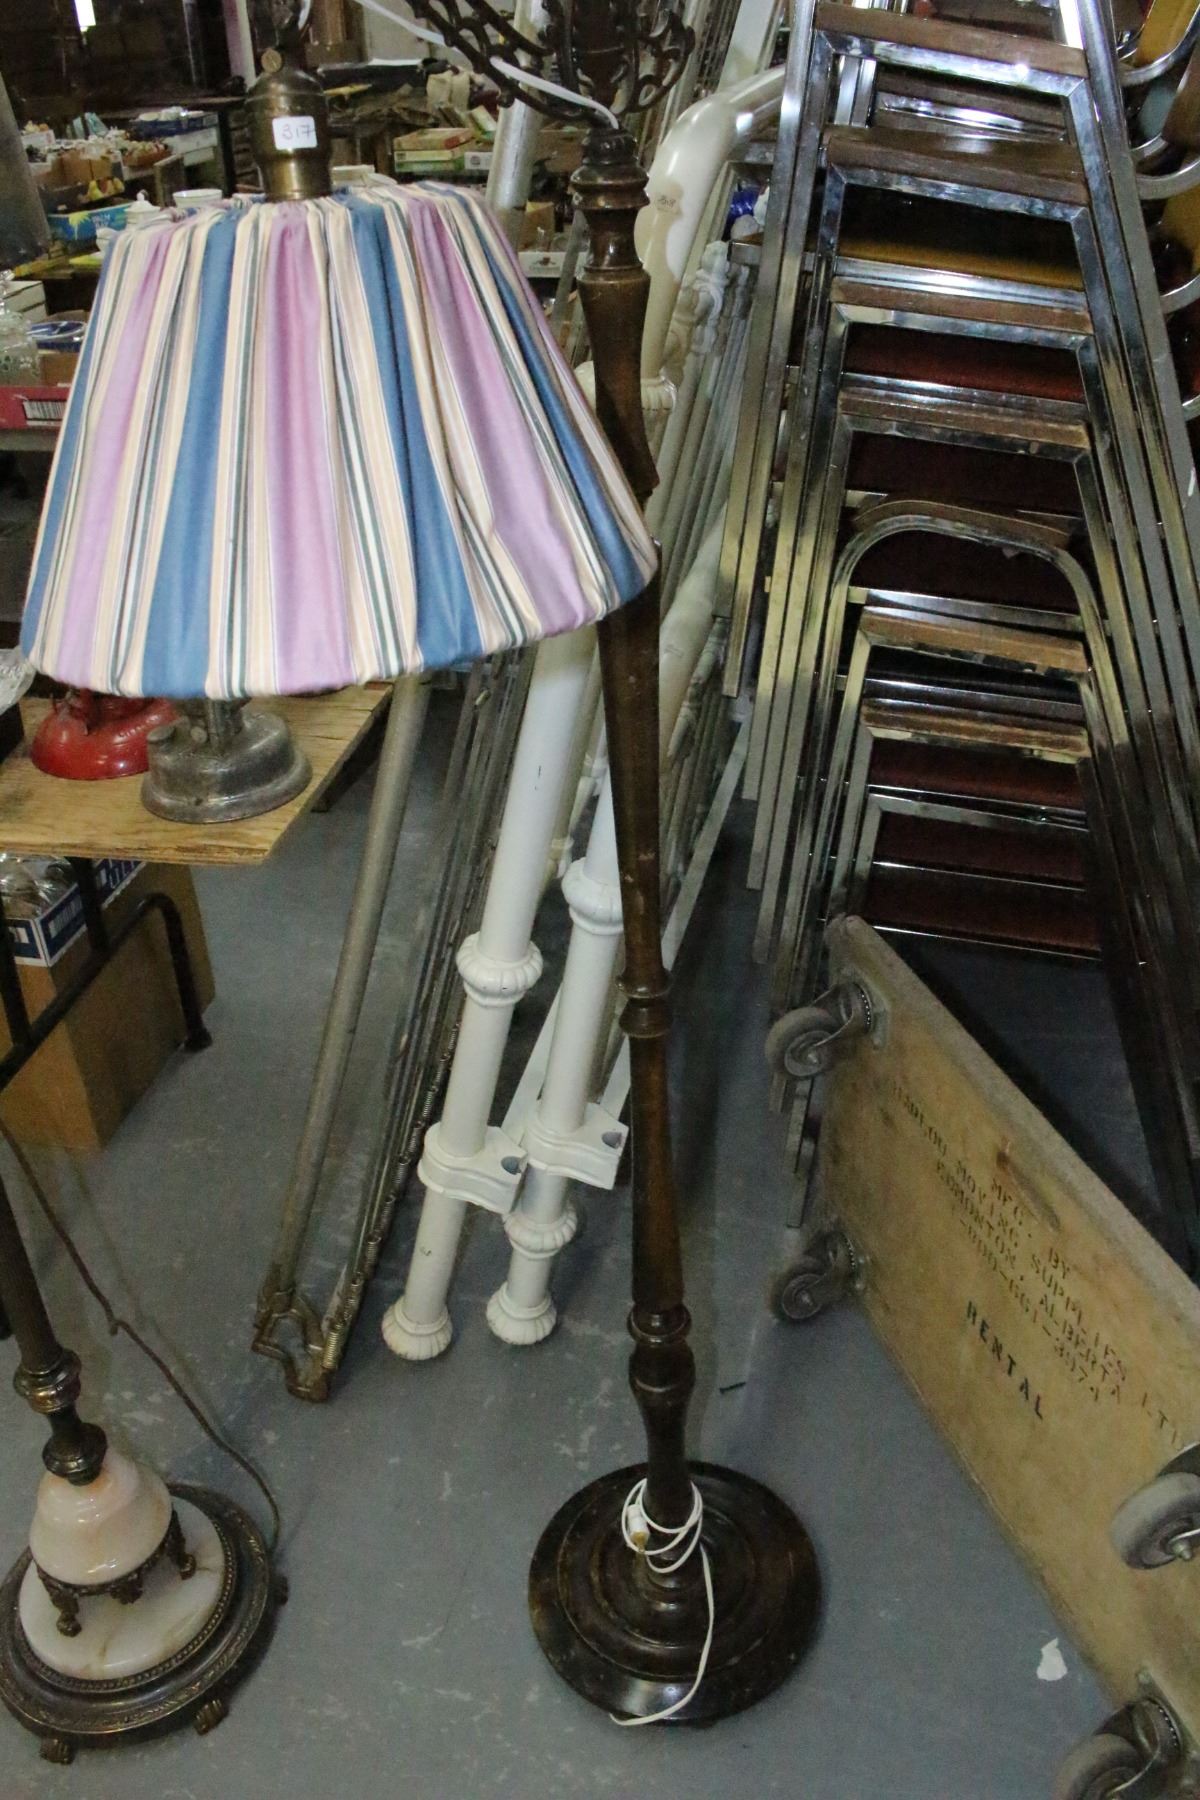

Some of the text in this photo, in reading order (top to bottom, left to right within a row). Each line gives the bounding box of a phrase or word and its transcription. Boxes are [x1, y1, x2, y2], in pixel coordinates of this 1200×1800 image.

[956, 1160, 1019, 1248] MOVING
[1031, 1253, 1126, 1382] SUPPLIES
[1048, 1248, 1071, 1280] BY
[966, 1299, 1044, 1421] RENTAL
[1039, 1293, 1121, 1404] ALBERTA
